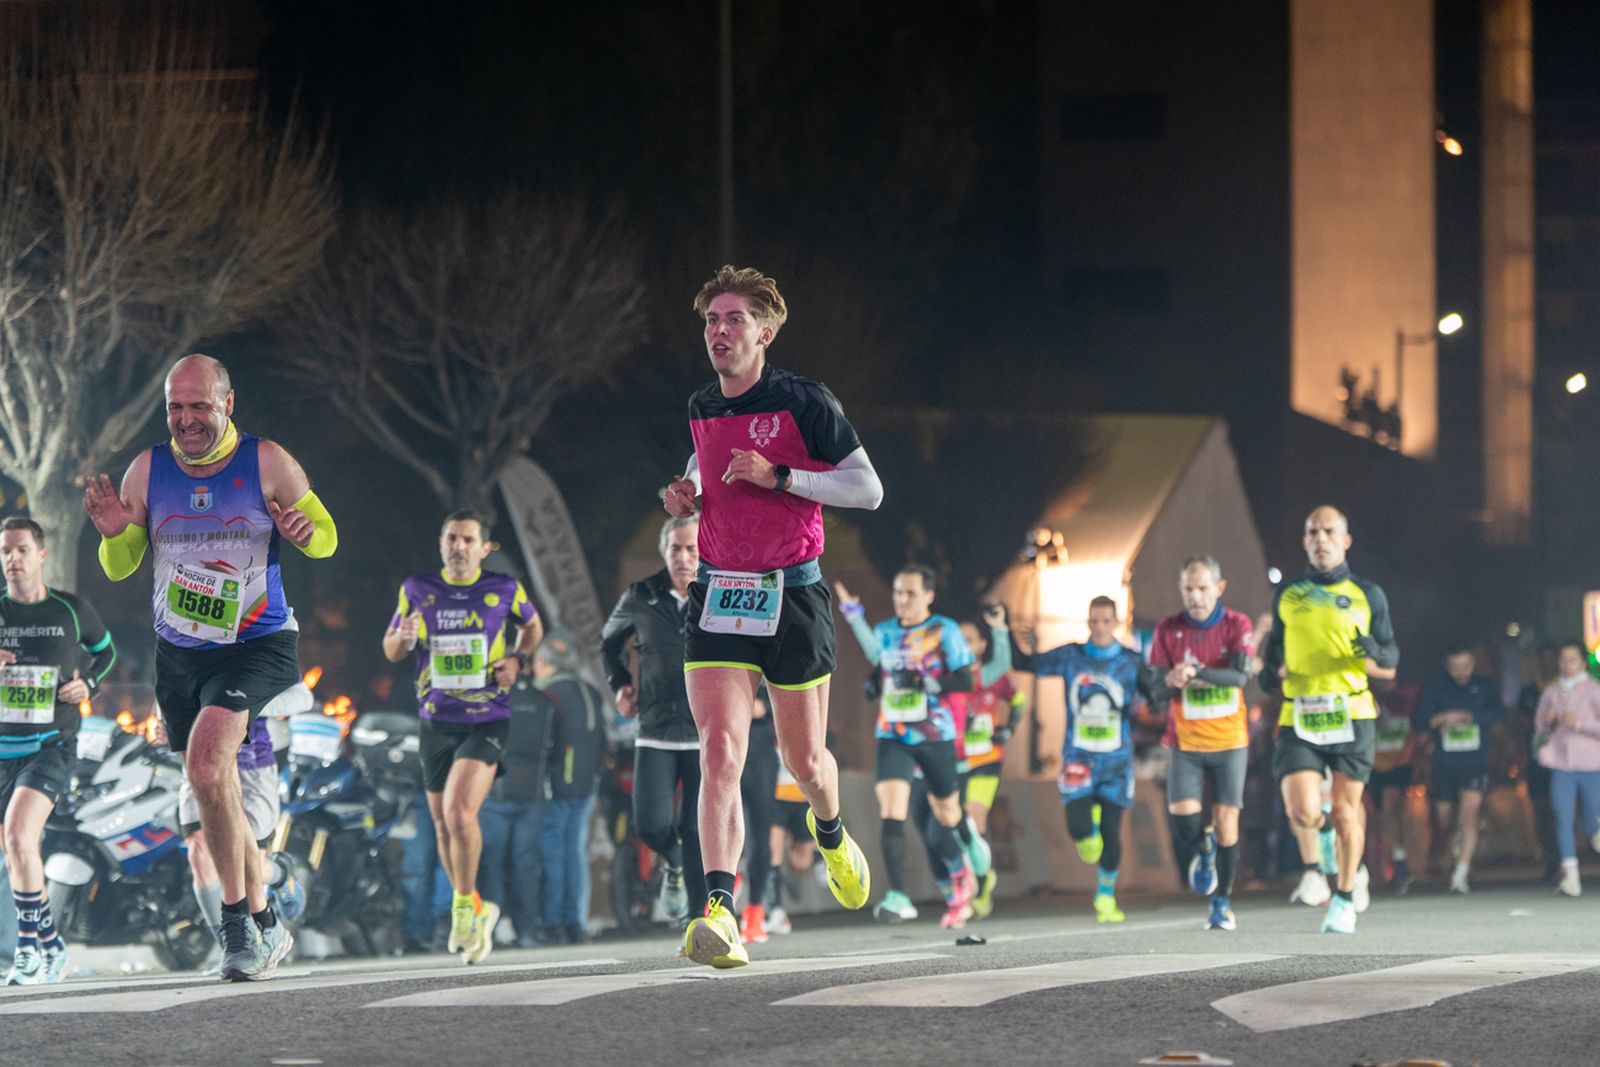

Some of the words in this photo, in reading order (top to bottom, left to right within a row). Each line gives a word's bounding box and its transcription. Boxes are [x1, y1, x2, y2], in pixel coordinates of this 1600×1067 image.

[200, 531, 206, 540] Y
[174, 575, 188, 587] SAN
[187, 582, 215, 595] ANTÓN
[183, 571, 207, 585] NOCHE
[206, 578, 217, 587] DE
[178, 588, 226, 620] 1588
[719, 588, 768, 612] 8232
[444, 654, 473, 671] 908
[7, 686, 46, 704] 2528
